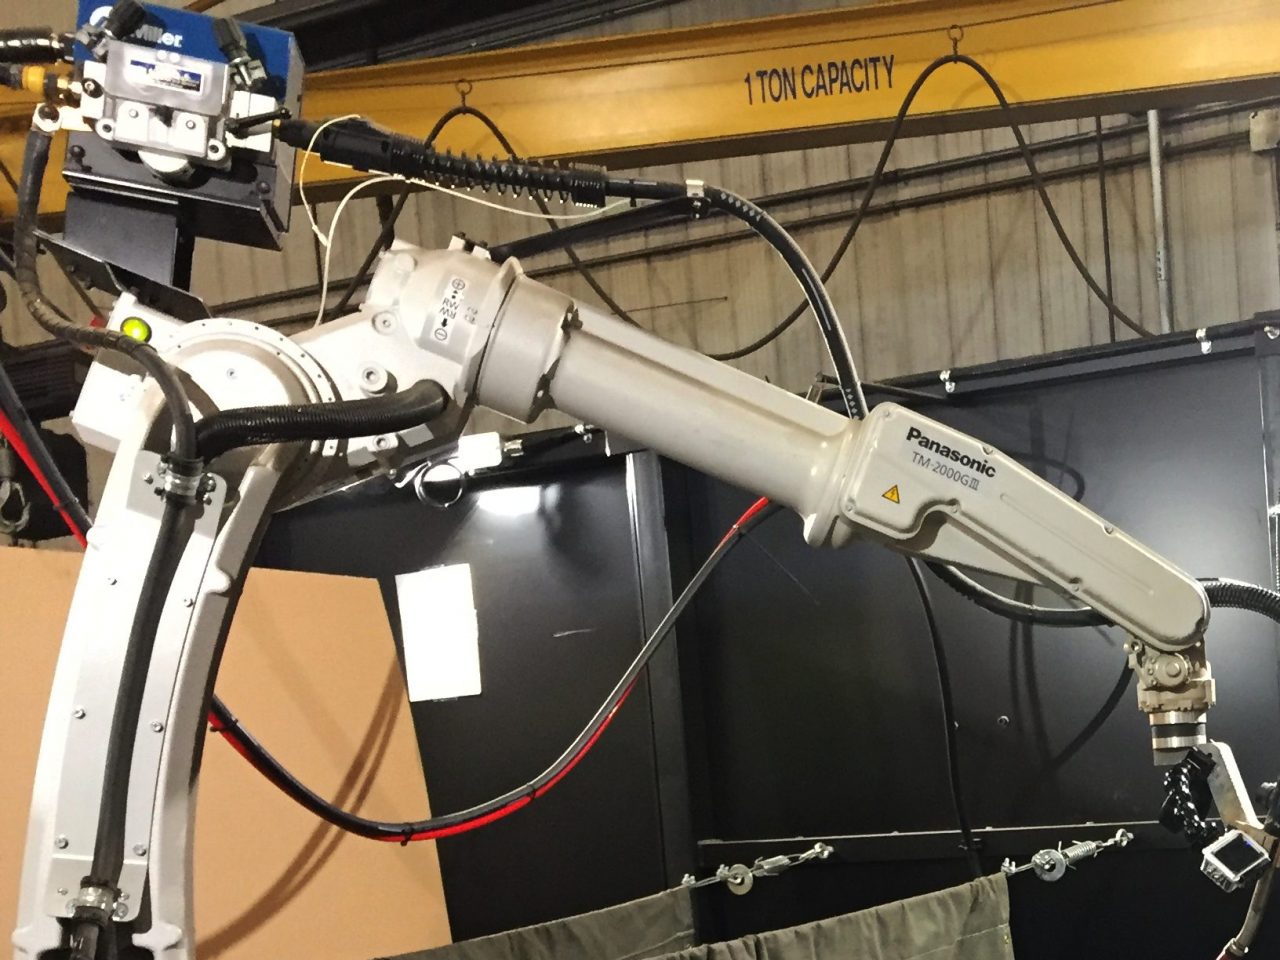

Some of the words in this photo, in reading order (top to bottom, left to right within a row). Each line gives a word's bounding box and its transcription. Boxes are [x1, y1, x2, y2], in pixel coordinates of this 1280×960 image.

[744, 72, 753, 105] 1
[755, 67, 797, 103] TON
[801, 54, 895, 99] CAPACITY
[906, 426, 996, 478] Panasonic
